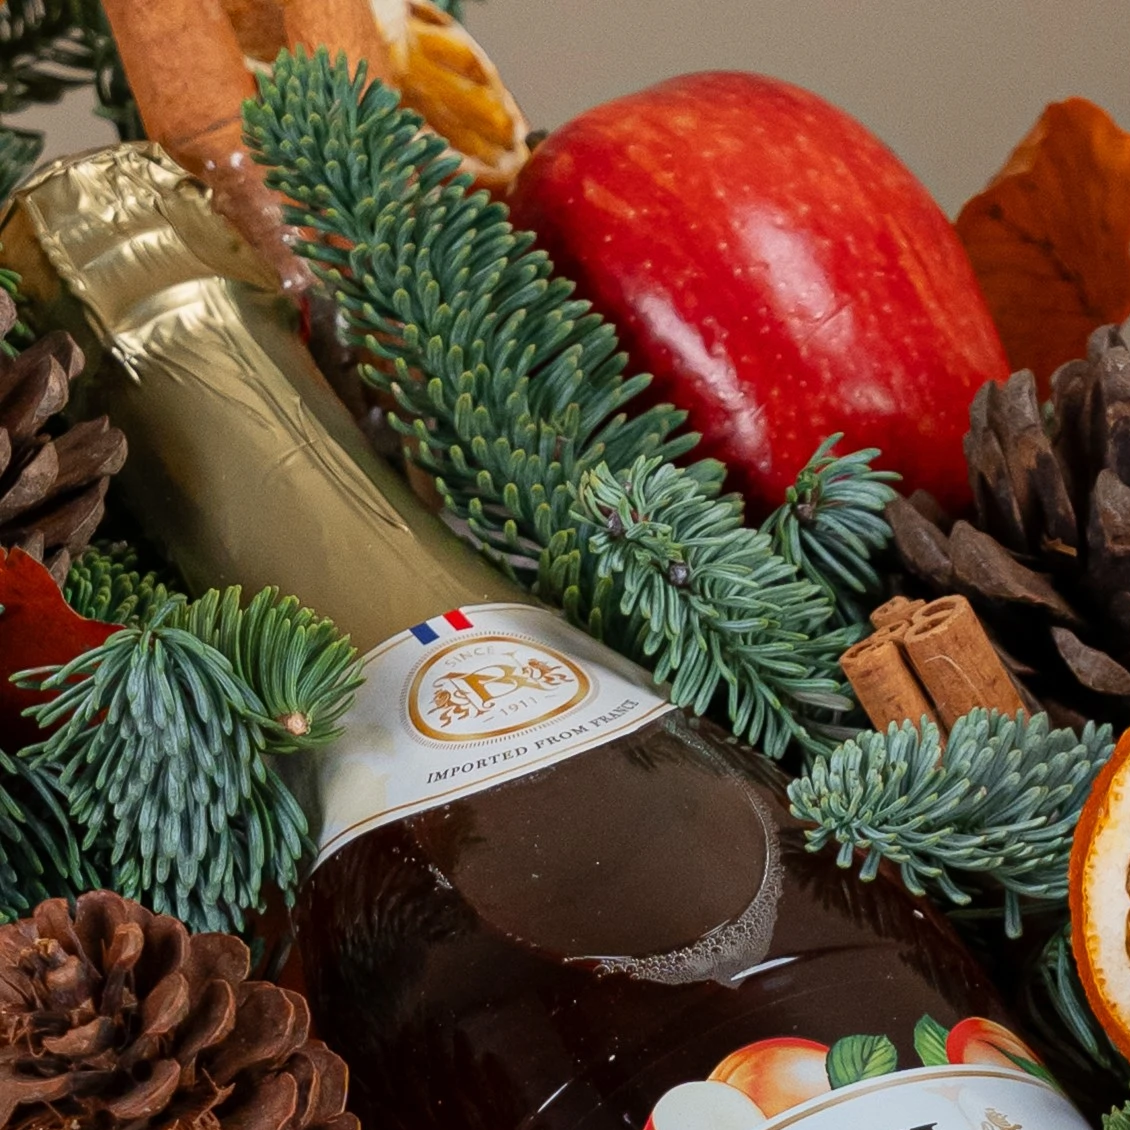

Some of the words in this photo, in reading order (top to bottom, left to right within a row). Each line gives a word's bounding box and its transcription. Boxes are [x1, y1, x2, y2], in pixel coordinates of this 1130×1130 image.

[445, 646, 495, 668] SINCE
[500, 696, 538, 716] 1911
[426, 745, 528, 784] IMPORTED
[535, 724, 588, 751] FROM
[590, 698, 640, 730] FRANCE
